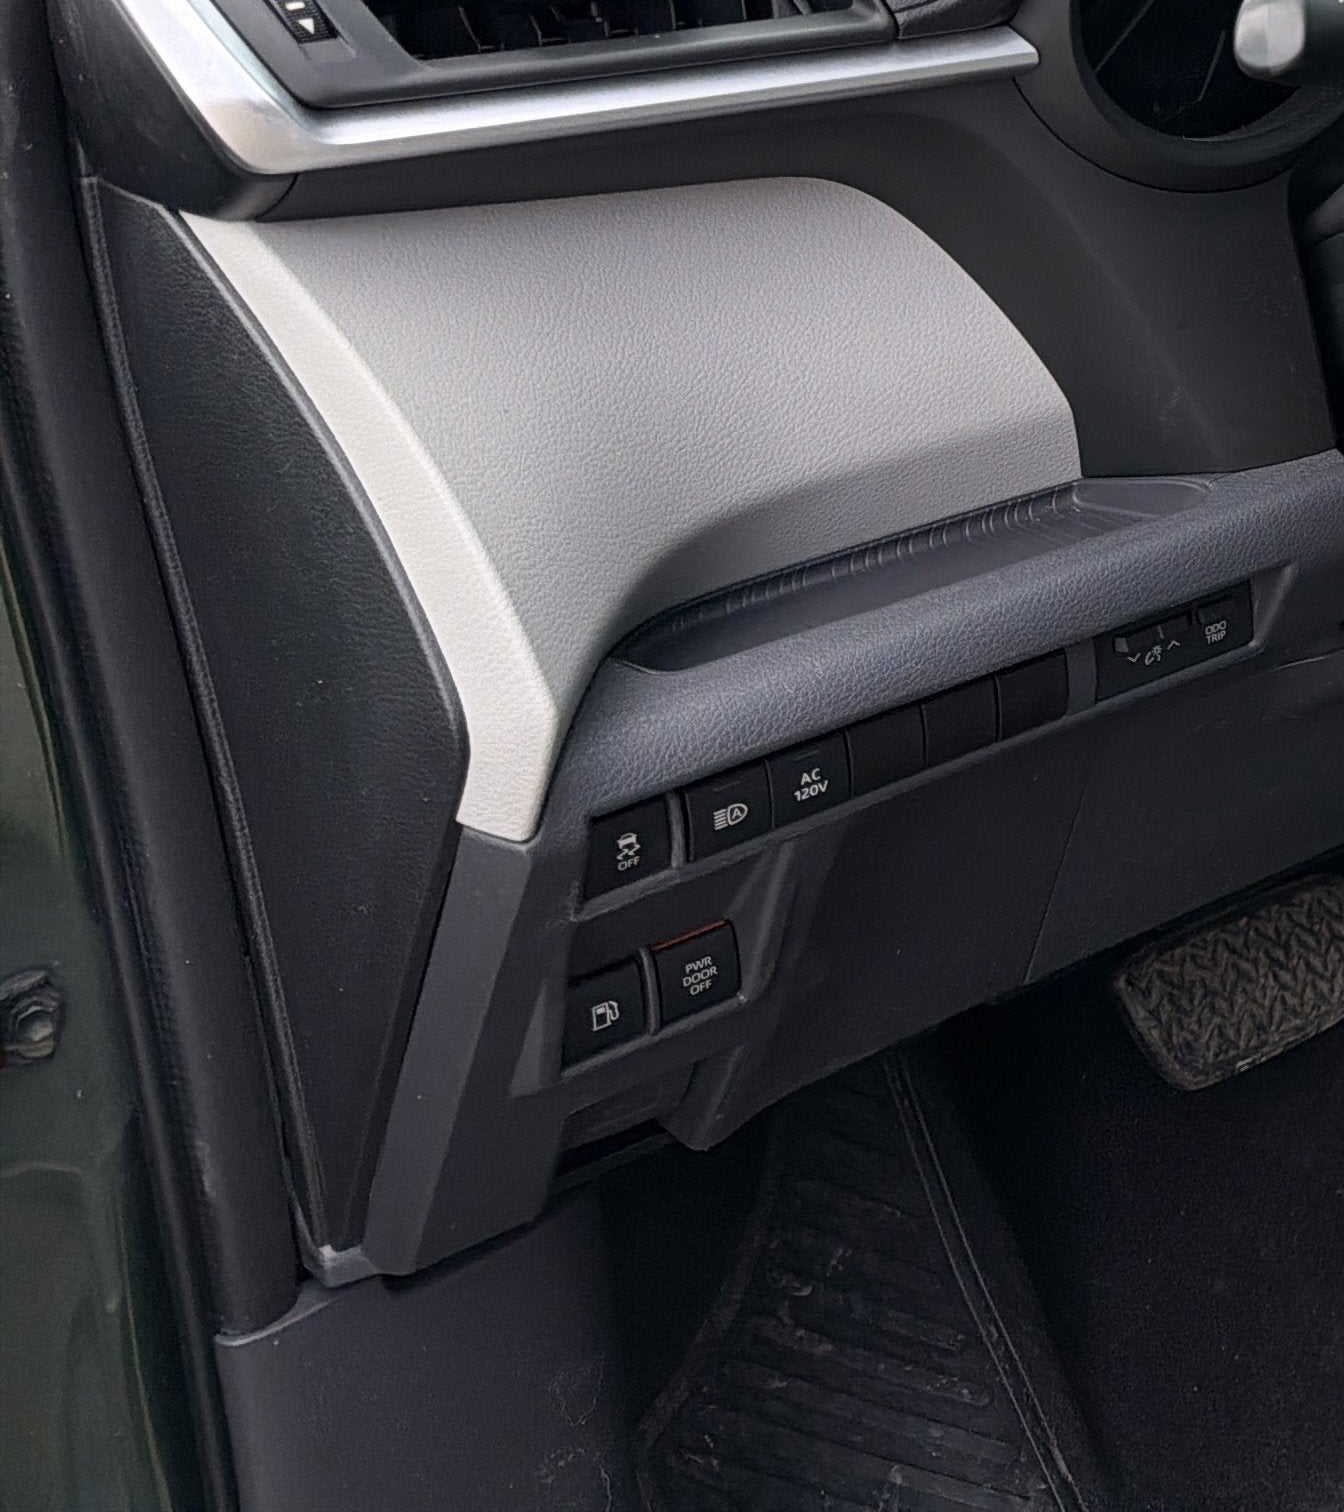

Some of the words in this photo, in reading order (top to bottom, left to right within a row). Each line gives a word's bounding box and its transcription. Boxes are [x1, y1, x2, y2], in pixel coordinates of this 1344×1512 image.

[1205, 630, 1227, 645] TRIP
[800, 767, 822, 786] AC
[793, 779, 829, 802] 120V
[617, 855, 641, 872] OFF
[684, 955, 713, 975] PWR
[682, 965, 719, 988] DOOR
[689, 979, 713, 996] OFF
